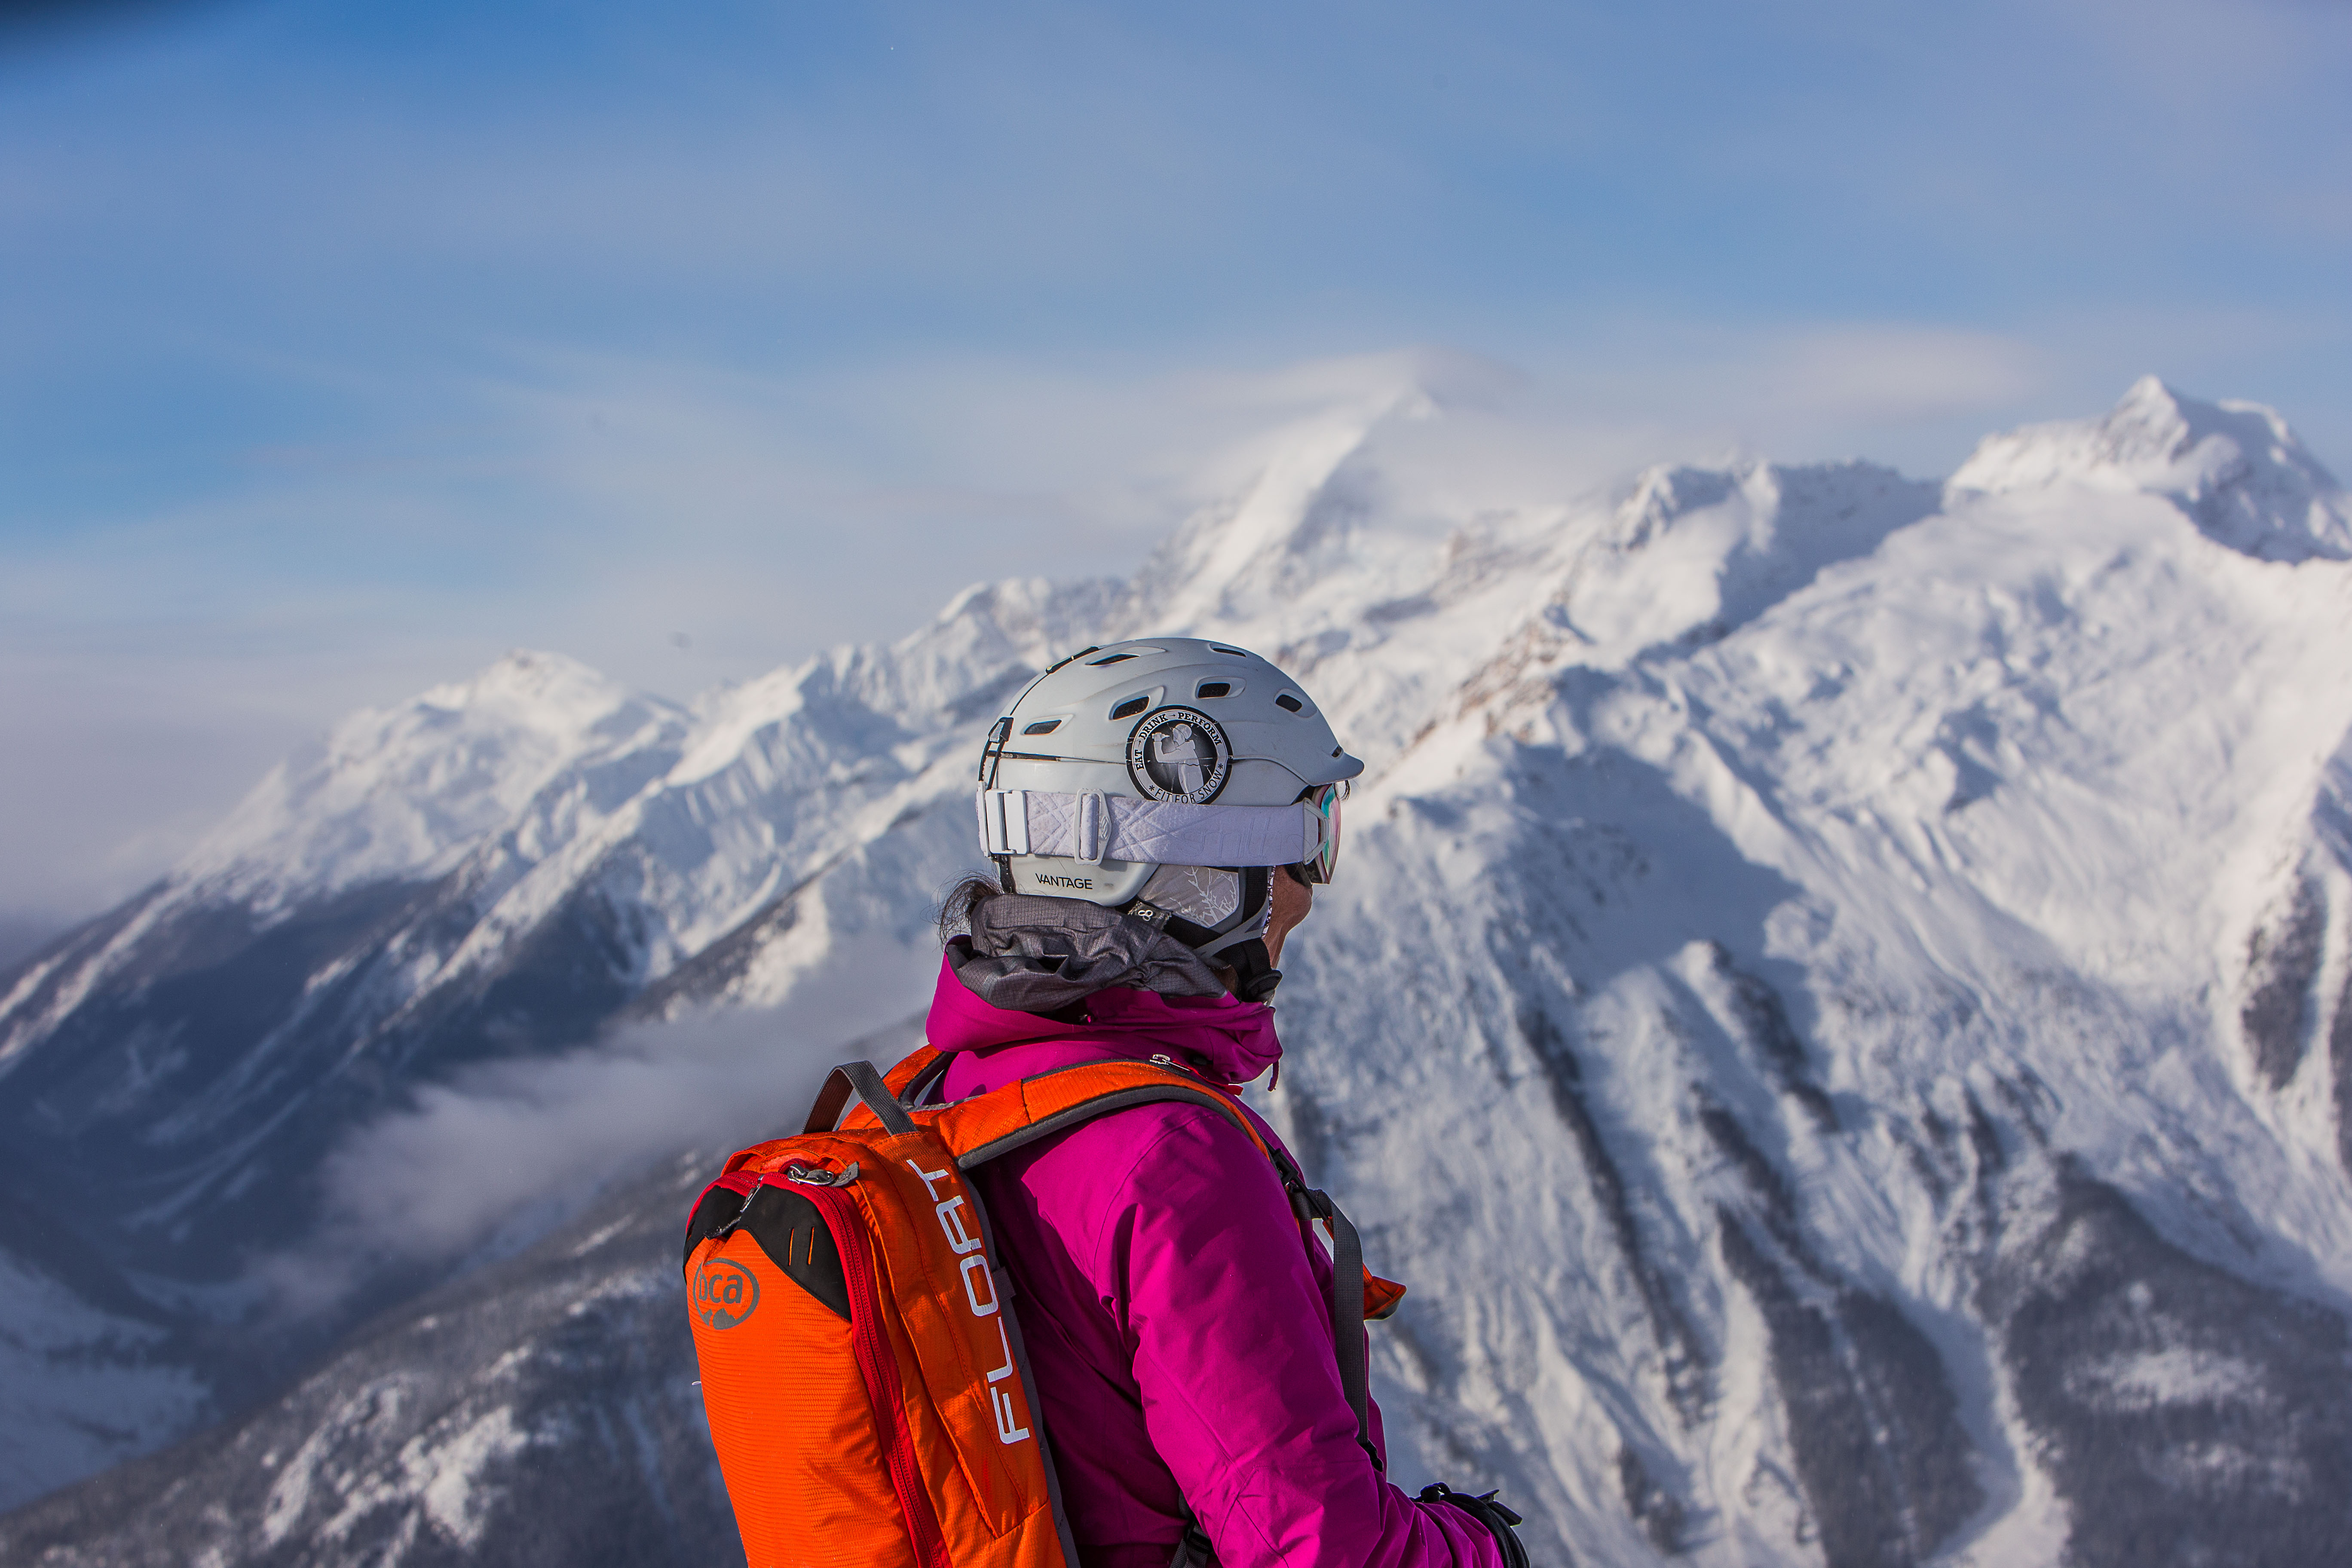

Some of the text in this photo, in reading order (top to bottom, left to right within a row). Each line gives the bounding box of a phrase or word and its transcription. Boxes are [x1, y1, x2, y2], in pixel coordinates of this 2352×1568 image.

[1135, 712, 1222, 770] EAT DRINK PERFORM
[1155, 769, 1222, 804] FIT FOR SNOW
[1035, 873, 1093, 890] VANTAGE
[698, 1269, 743, 1304] bca
[906, 1159, 1030, 1445] FLOAT
